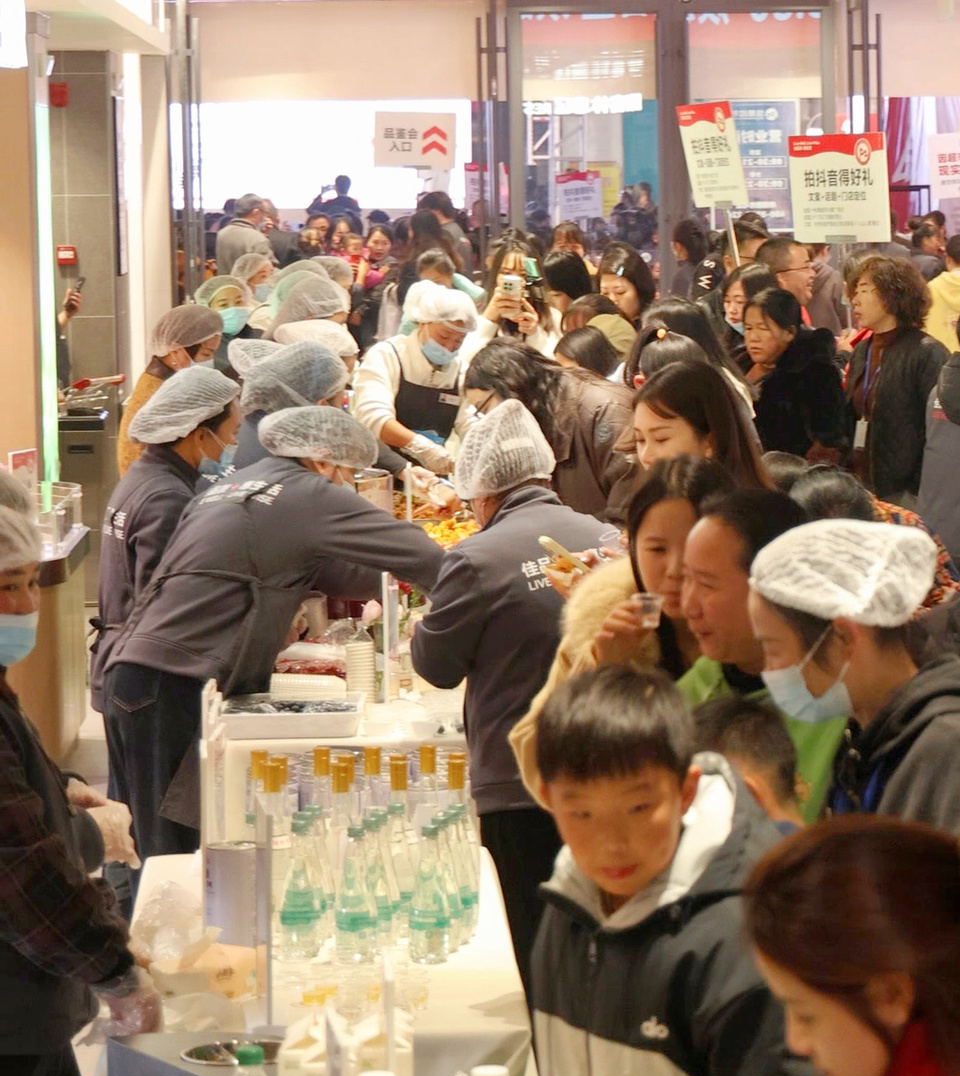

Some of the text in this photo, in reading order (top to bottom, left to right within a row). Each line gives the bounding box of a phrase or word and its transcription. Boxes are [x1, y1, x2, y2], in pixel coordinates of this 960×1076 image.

[383, 127, 419, 140] 品鉴会
[388, 141, 412, 152] 入口
[803, 168, 874, 188] 拍抖音得好礼
[527, 577, 553, 591] LIVE
